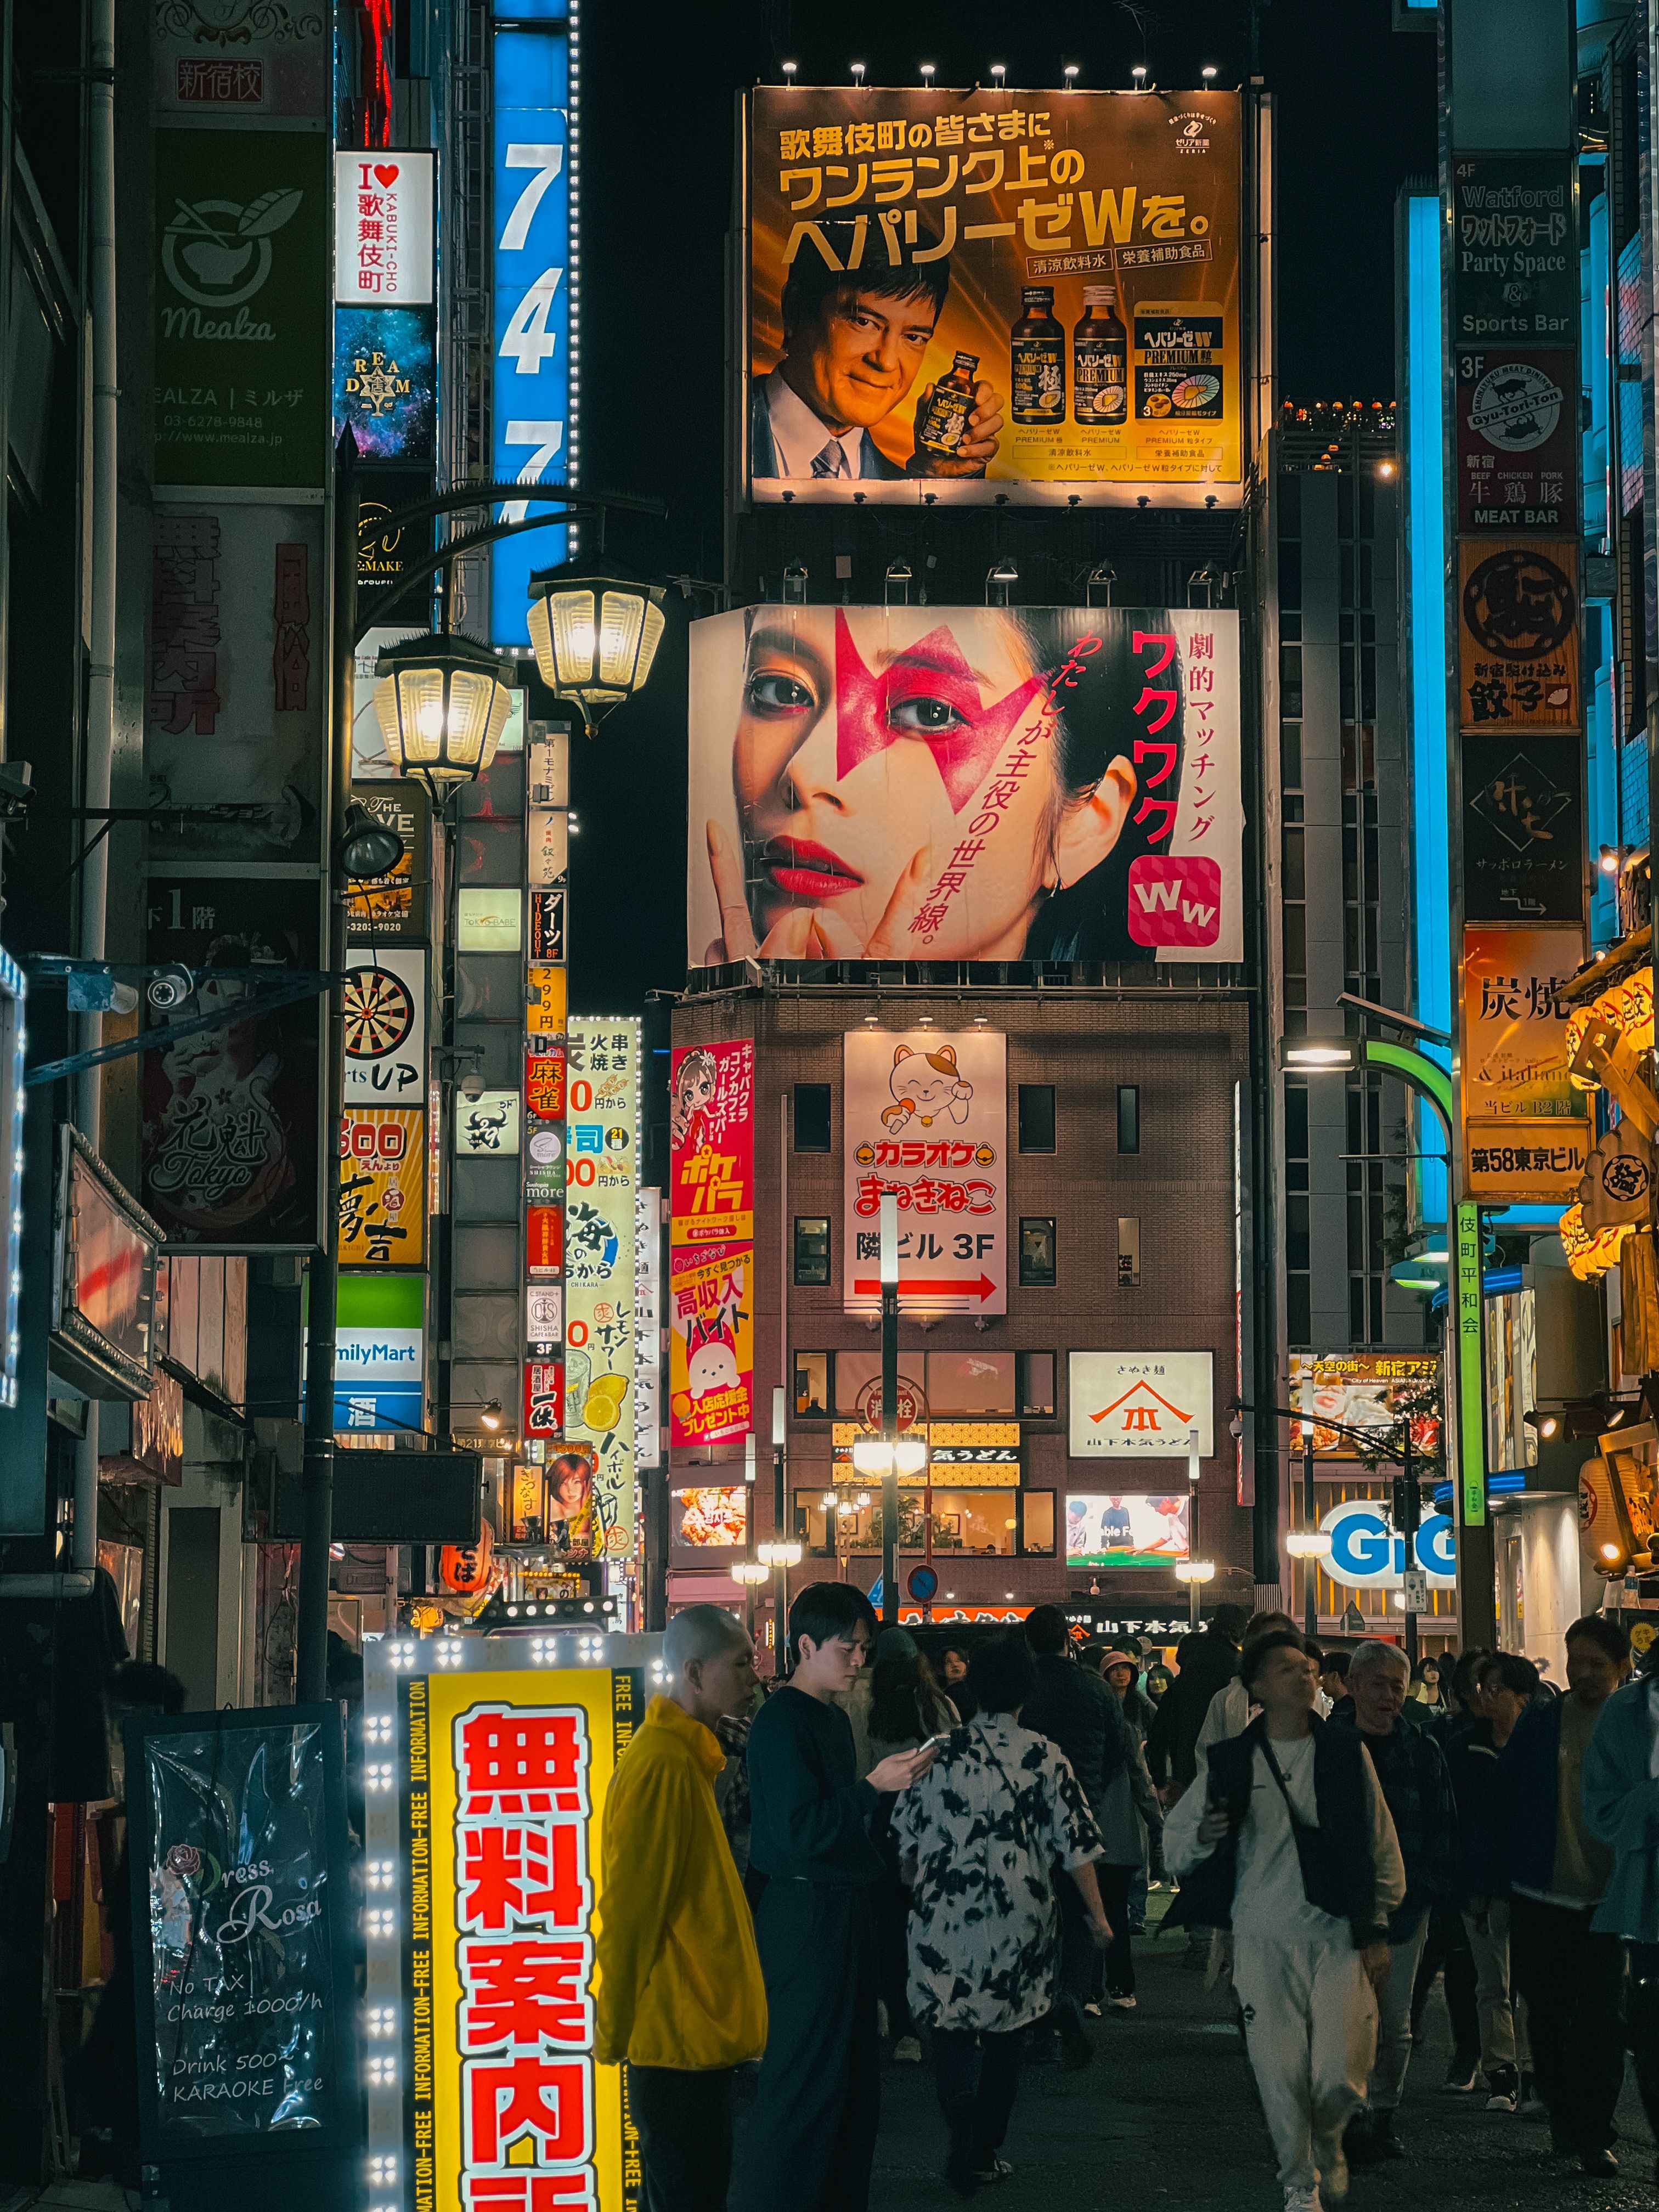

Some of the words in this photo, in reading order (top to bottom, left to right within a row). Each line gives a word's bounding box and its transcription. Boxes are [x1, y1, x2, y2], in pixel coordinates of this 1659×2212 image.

[179, 63, 262, 100] 新宿校
[779, 111, 1051, 161] 歌舞伎町の皆さまに
[358, 163, 373, 190] I
[780, 148, 1085, 210] ワンランク上の
[1457, 164, 1475, 177] 4F
[1462, 185, 1564, 208] Watford
[357, 193, 385, 293] 歌舞伎町
[386, 193, 398, 292] KABUKI-CHO
[781, 187, 1209, 272] ヘパリーゼWを。
[1461, 212, 1567, 247] ワットフォード
[1034, 253, 1107, 274] 清涼飲料水
[1122, 244, 1205, 264] 栄養補助食品
[1462, 251, 1510, 278] Party
[1514, 251, 1566, 278] Space
[1509, 285, 1522, 302] &
[161, 306, 276, 341] Mealza
[1463, 314, 1528, 335] Sports
[1535, 314, 1569, 332] Bar
[1144, 331, 1212, 348] ヘパリーゼW
[1144, 349, 1199, 364] PREMIUM
[1461, 356, 1485, 379] 3F
[1077, 369, 1124, 382] PREMIUM
[1502, 365, 1523, 374] MEAT
[1526, 368, 1551, 389] DINING
[245, 388, 304, 407] ミルザ
[1472, 391, 1559, 425] Gyu-Tori-Ton
[164, 415, 263, 428] 03-6278-9848
[1048, 448, 1092, 457] 清涼飲料水
[1155, 449, 1205, 458] 栄養補助食品
[1466, 454, 1495, 469] 新宿
[1471, 472, 1491, 480] BEEF
[1468, 481, 1491, 504] 牛
[1504, 482, 1526, 504] 鶏
[1539, 482, 1564, 504] 豚
[1474, 510, 1521, 523] MEAT
[1524, 510, 1559, 523] BAR
[1466, 678, 1544, 722] 餃子
[1132, 631, 1178, 844] ワクワク
[1188, 632, 1216, 842] 劇的マッチング
[907, 630, 1102, 945] わたしが主役の世界線。
[367, 796, 402, 812] THE
[1475, 859, 1568, 871] サッポロラーメン
[544, 893, 563, 946] ダーツ
[546, 949, 559, 958] 8F
[539, 968, 554, 1029] 299円
[1478, 975, 1571, 1021] 炭焼
[371, 1063, 419, 1093] UP
[529, 1059, 562, 1111] 麻雀
[728, 1051, 741, 1124] コンカフェ
[738, 1043, 752, 1124] キャバクラ
[715, 1057, 730, 1144] ガールズバー
[1483, 1100, 1527, 1115] 当ビル
[160, 1094, 271, 1164] 花魁
[527, 1110, 538, 1120] 6F
[527, 1126, 538, 1135] 5F
[610, 1128, 623, 1139] 21
[360, 1160, 399, 1171] えんより
[680, 1144, 737, 1185] ポケ
[875, 1140, 977, 1167] カラオケ
[1471, 1147, 1585, 1173] 第58東京ビル
[149, 1153, 252, 1200] Tokyo
[526, 1188, 564, 1198] more
[691, 1176, 744, 1214] パラ
[854, 1172, 997, 1218] まねきねこ
[952, 1233, 995, 1260] 3F
[696, 1254, 751, 1280] 今すぐ見つかる
[1459, 1205, 1479, 1334] 伎町平和会
[675, 1273, 744, 1320] 高収入
[613, 1300, 631, 1348] レモン
[686, 1303, 749, 1349] バイト
[536, 1344, 552, 1355] 3F
[594, 1324, 617, 1370] サワー
[1115, 1364, 1166, 1376] さぬき麺
[348, 1397, 377, 1427] 酒
[692, 1386, 749, 1417] 入店応援金
[871, 1398, 913, 1419] 消栓
[682, 1403, 751, 1437] プレゼント中
[933, 1449, 1017, 1462] 気うどん
[1086, 1436, 1192, 1447] 山下本気うどん
[600, 1432, 630, 1490] ハイボール
[615, 1675, 631, 1711] FREE
[409, 1680, 427, 1782] INFORMATION
[216, 1884, 322, 1945] Rosa
[170, 1980, 194, 1996] No
[202, 1974, 245, 1993] TAX
[167, 2004, 235, 2023] Charge
[244, 1991, 323, 2016] 1000/h
[172, 2055, 227, 2076] Drink
[173, 2079, 274, 2102] KARAOKE
[283, 2076, 324, 2094] Free
